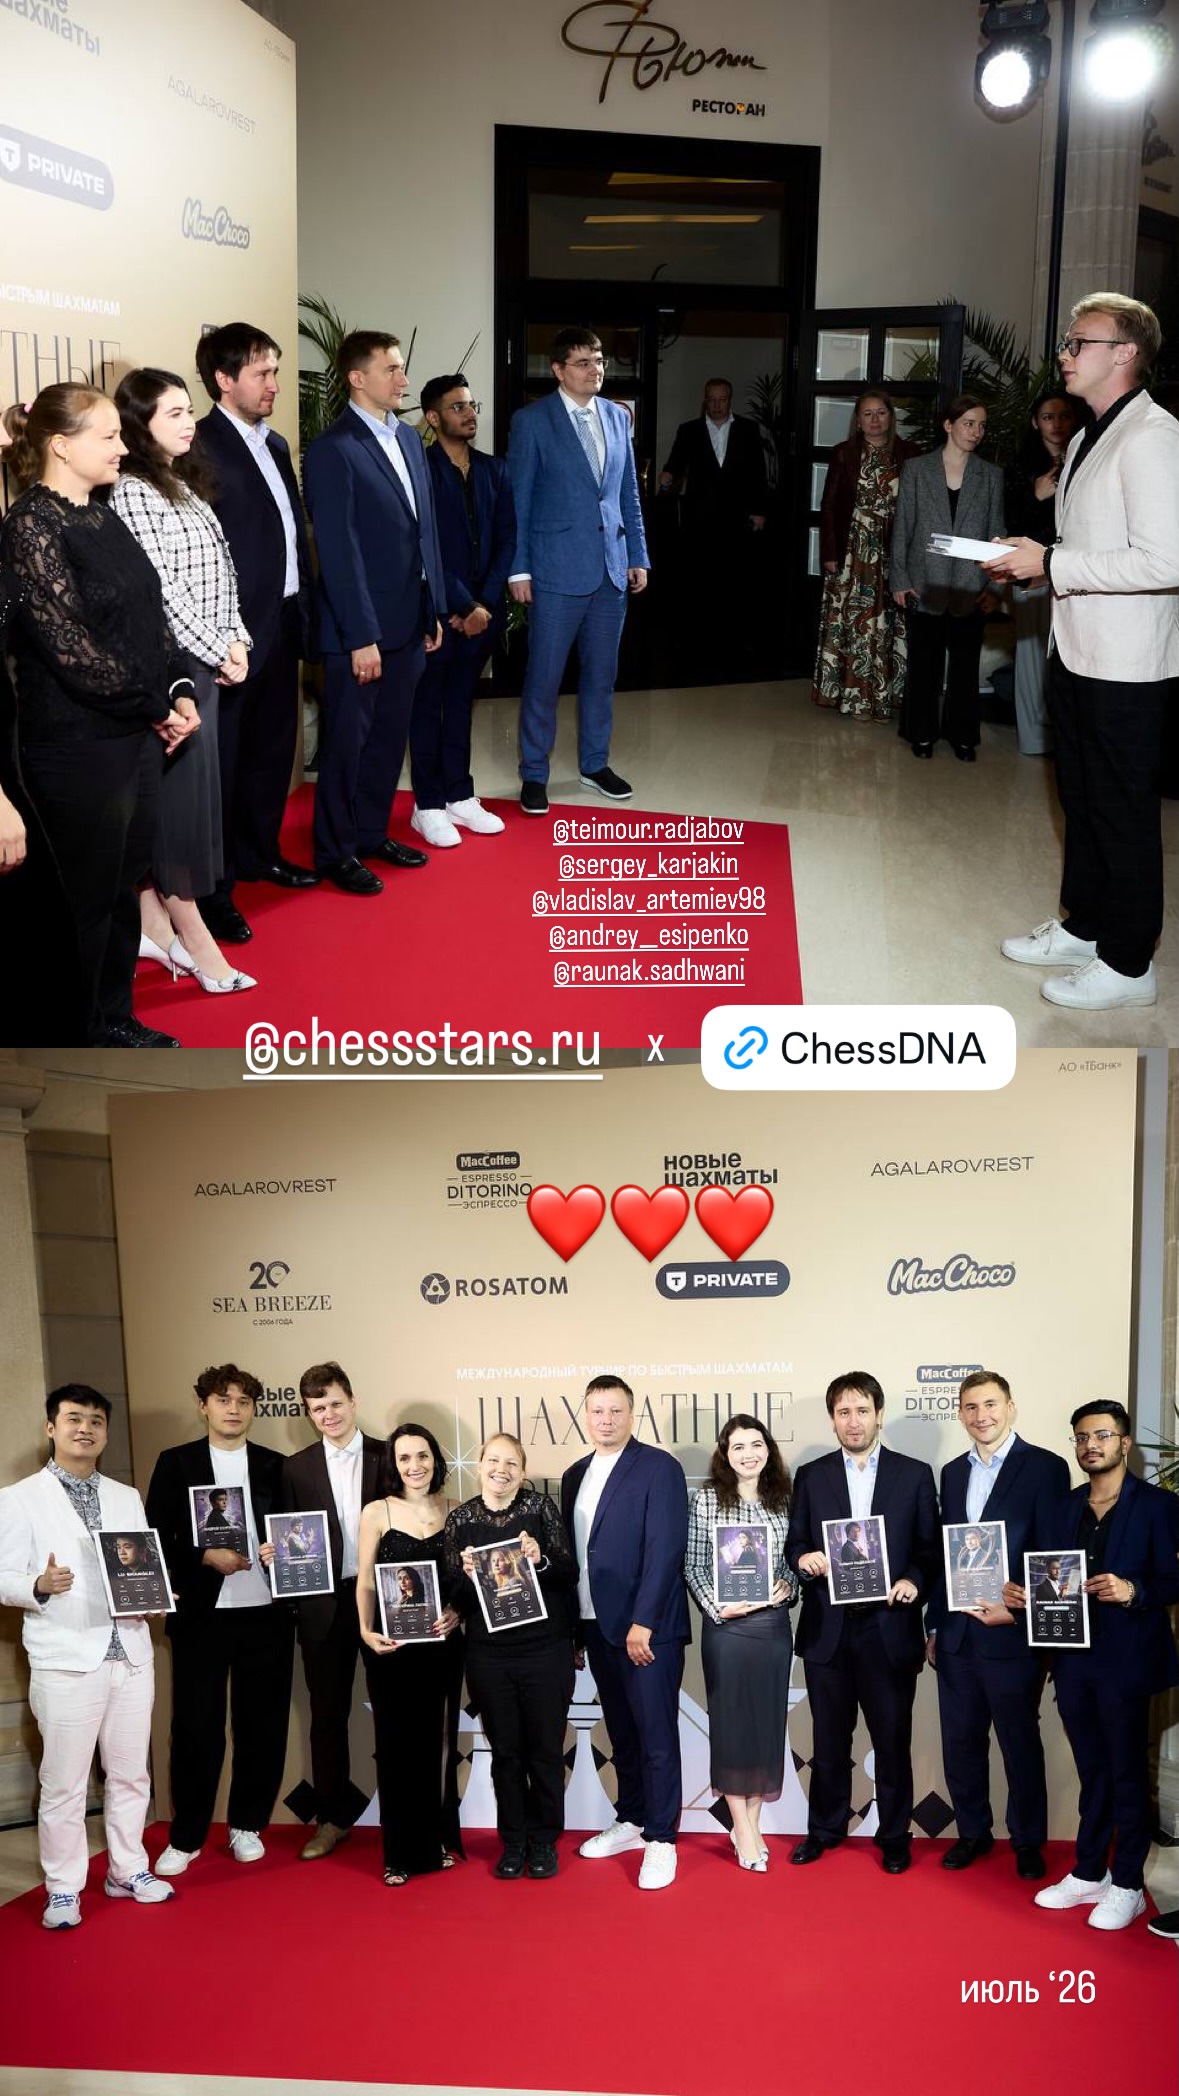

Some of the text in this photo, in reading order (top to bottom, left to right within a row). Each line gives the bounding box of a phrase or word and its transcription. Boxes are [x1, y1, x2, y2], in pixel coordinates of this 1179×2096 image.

[167, 74, 256, 135] AGALAROVREST
[692, 99, 766, 117] РЕСТОРАН
[27, 151, 105, 196] PRIVATE
[52, 291, 121, 317] ШАХМАТАМ
[460, 1154, 517, 1168] MacCoffee
[870, 1156, 1034, 1177] AGALAROVREST
[461, 1172, 517, 1183] ESPRESSO
[194, 1179, 336, 1197] AGALAROVREST
[462, 1199, 518, 1209] ЭСПРЕССО
[455, 1276, 569, 1297] ROSATOM
[693, 1272, 778, 1288] PRIVATE
[212, 1295, 332, 1313] SEA BREEZE
[456, 1365, 577, 1381] МЕЖДУНАРОДНЫЙ
[628, 1364, 648, 1377] ПО
[650, 1363, 710, 1376] БЫСТРЫМ
[713, 1361, 794, 1375] ШАХМАТАМ
[921, 1386, 961, 1395] ESPRE
[920, 1412, 959, 1421] ЭСПРЕ
